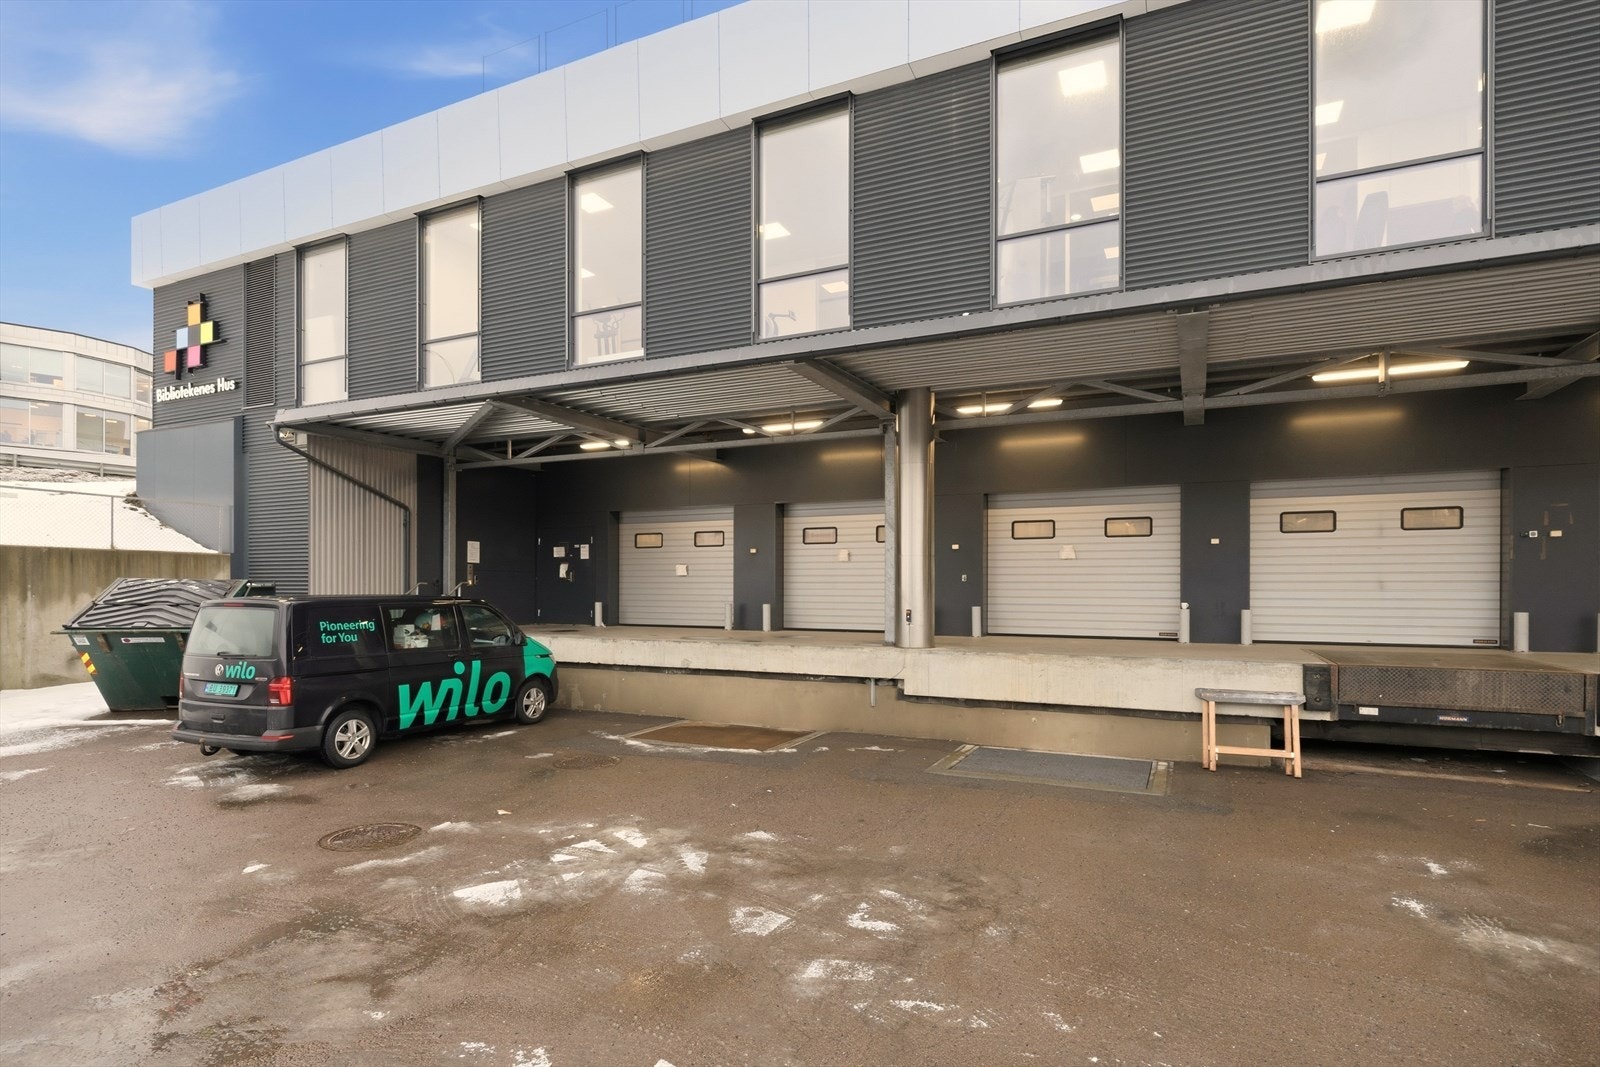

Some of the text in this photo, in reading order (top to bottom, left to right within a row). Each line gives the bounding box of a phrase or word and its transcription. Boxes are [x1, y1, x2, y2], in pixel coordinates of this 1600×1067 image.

[156, 377, 235, 402] Bibliotekenes Hus
[319, 620, 376, 632] Pioneering
[321, 632, 358, 644] for You
[225, 661, 256, 679] wilo
[398, 660, 511, 730] wilo
